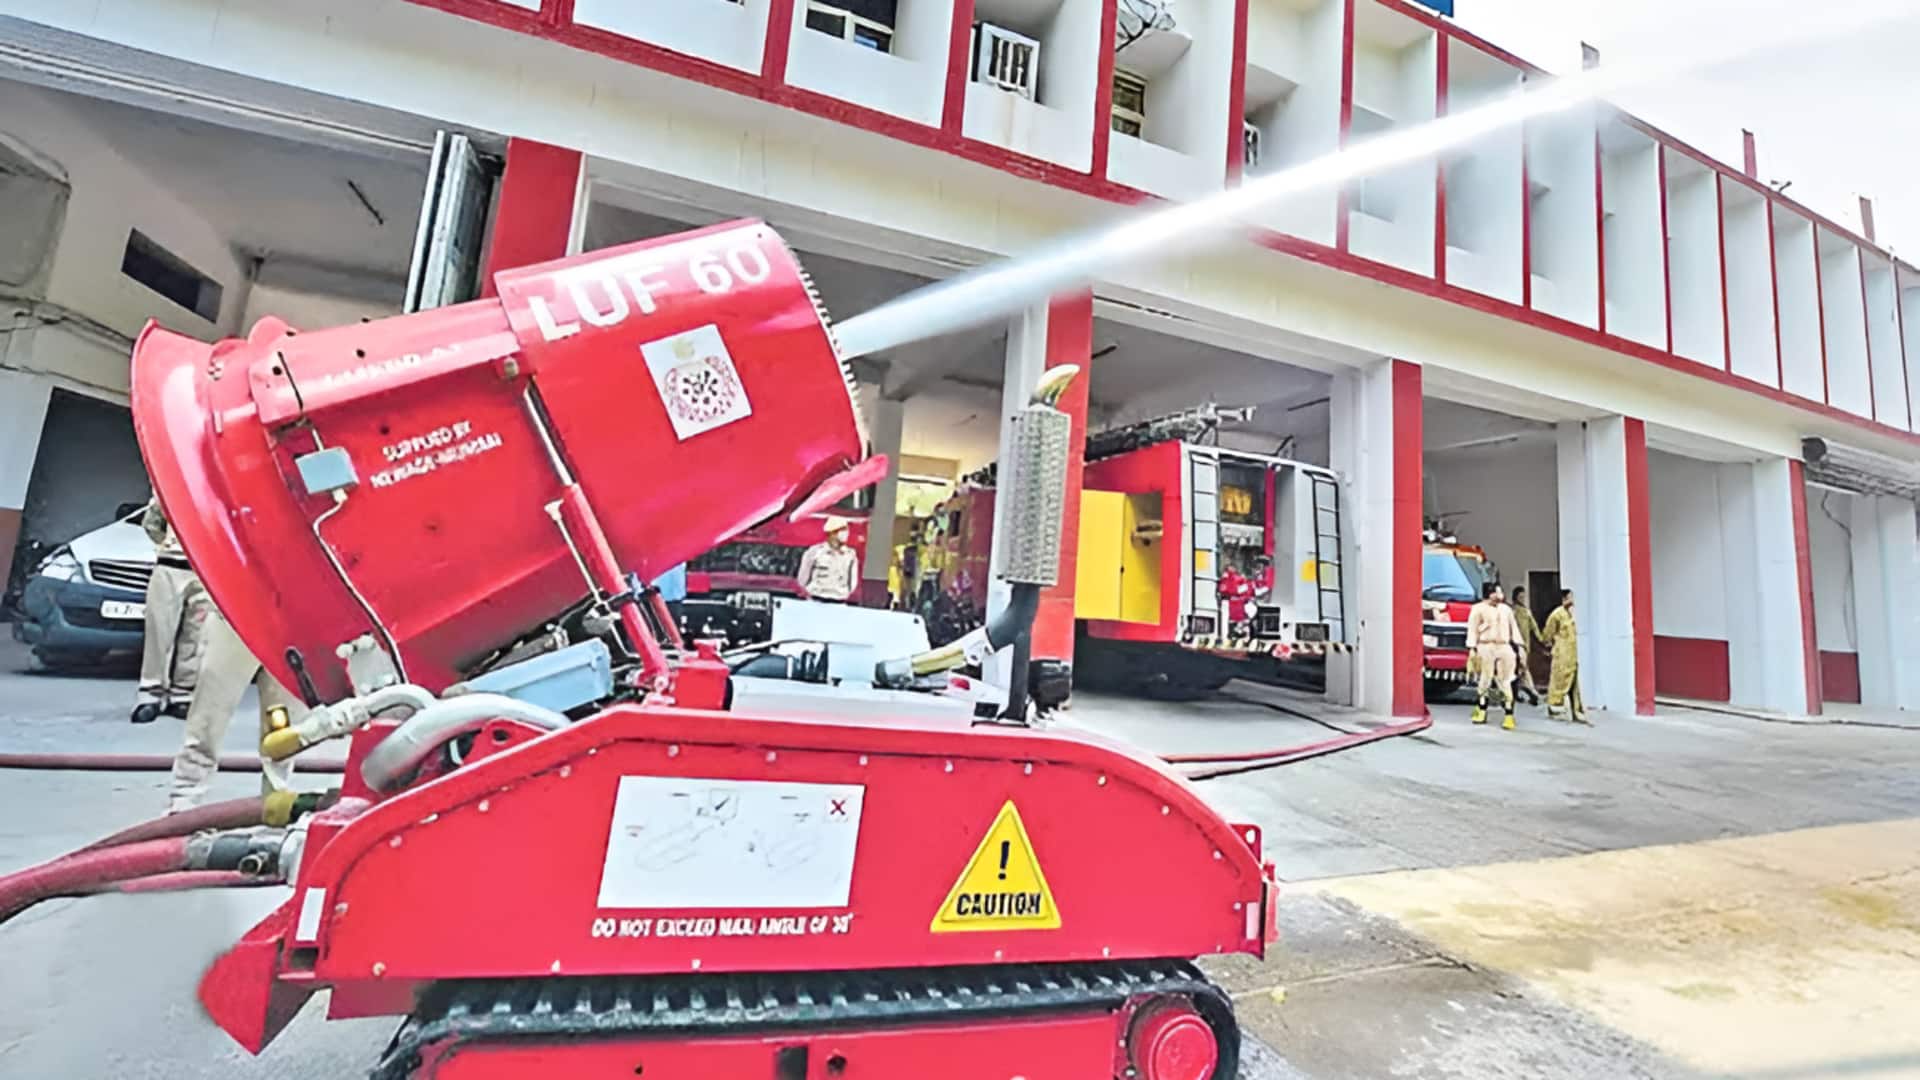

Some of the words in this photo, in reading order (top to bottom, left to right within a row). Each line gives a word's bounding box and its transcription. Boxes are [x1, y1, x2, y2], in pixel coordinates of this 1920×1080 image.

[527, 264, 670, 341] LUF
[689, 244, 771, 294] 60
[957, 892, 1041, 916] CAUTION
[591, 918, 616, 937] DO
[619, 918, 652, 937] NOT
[656, 918, 717, 936] EXCEED
